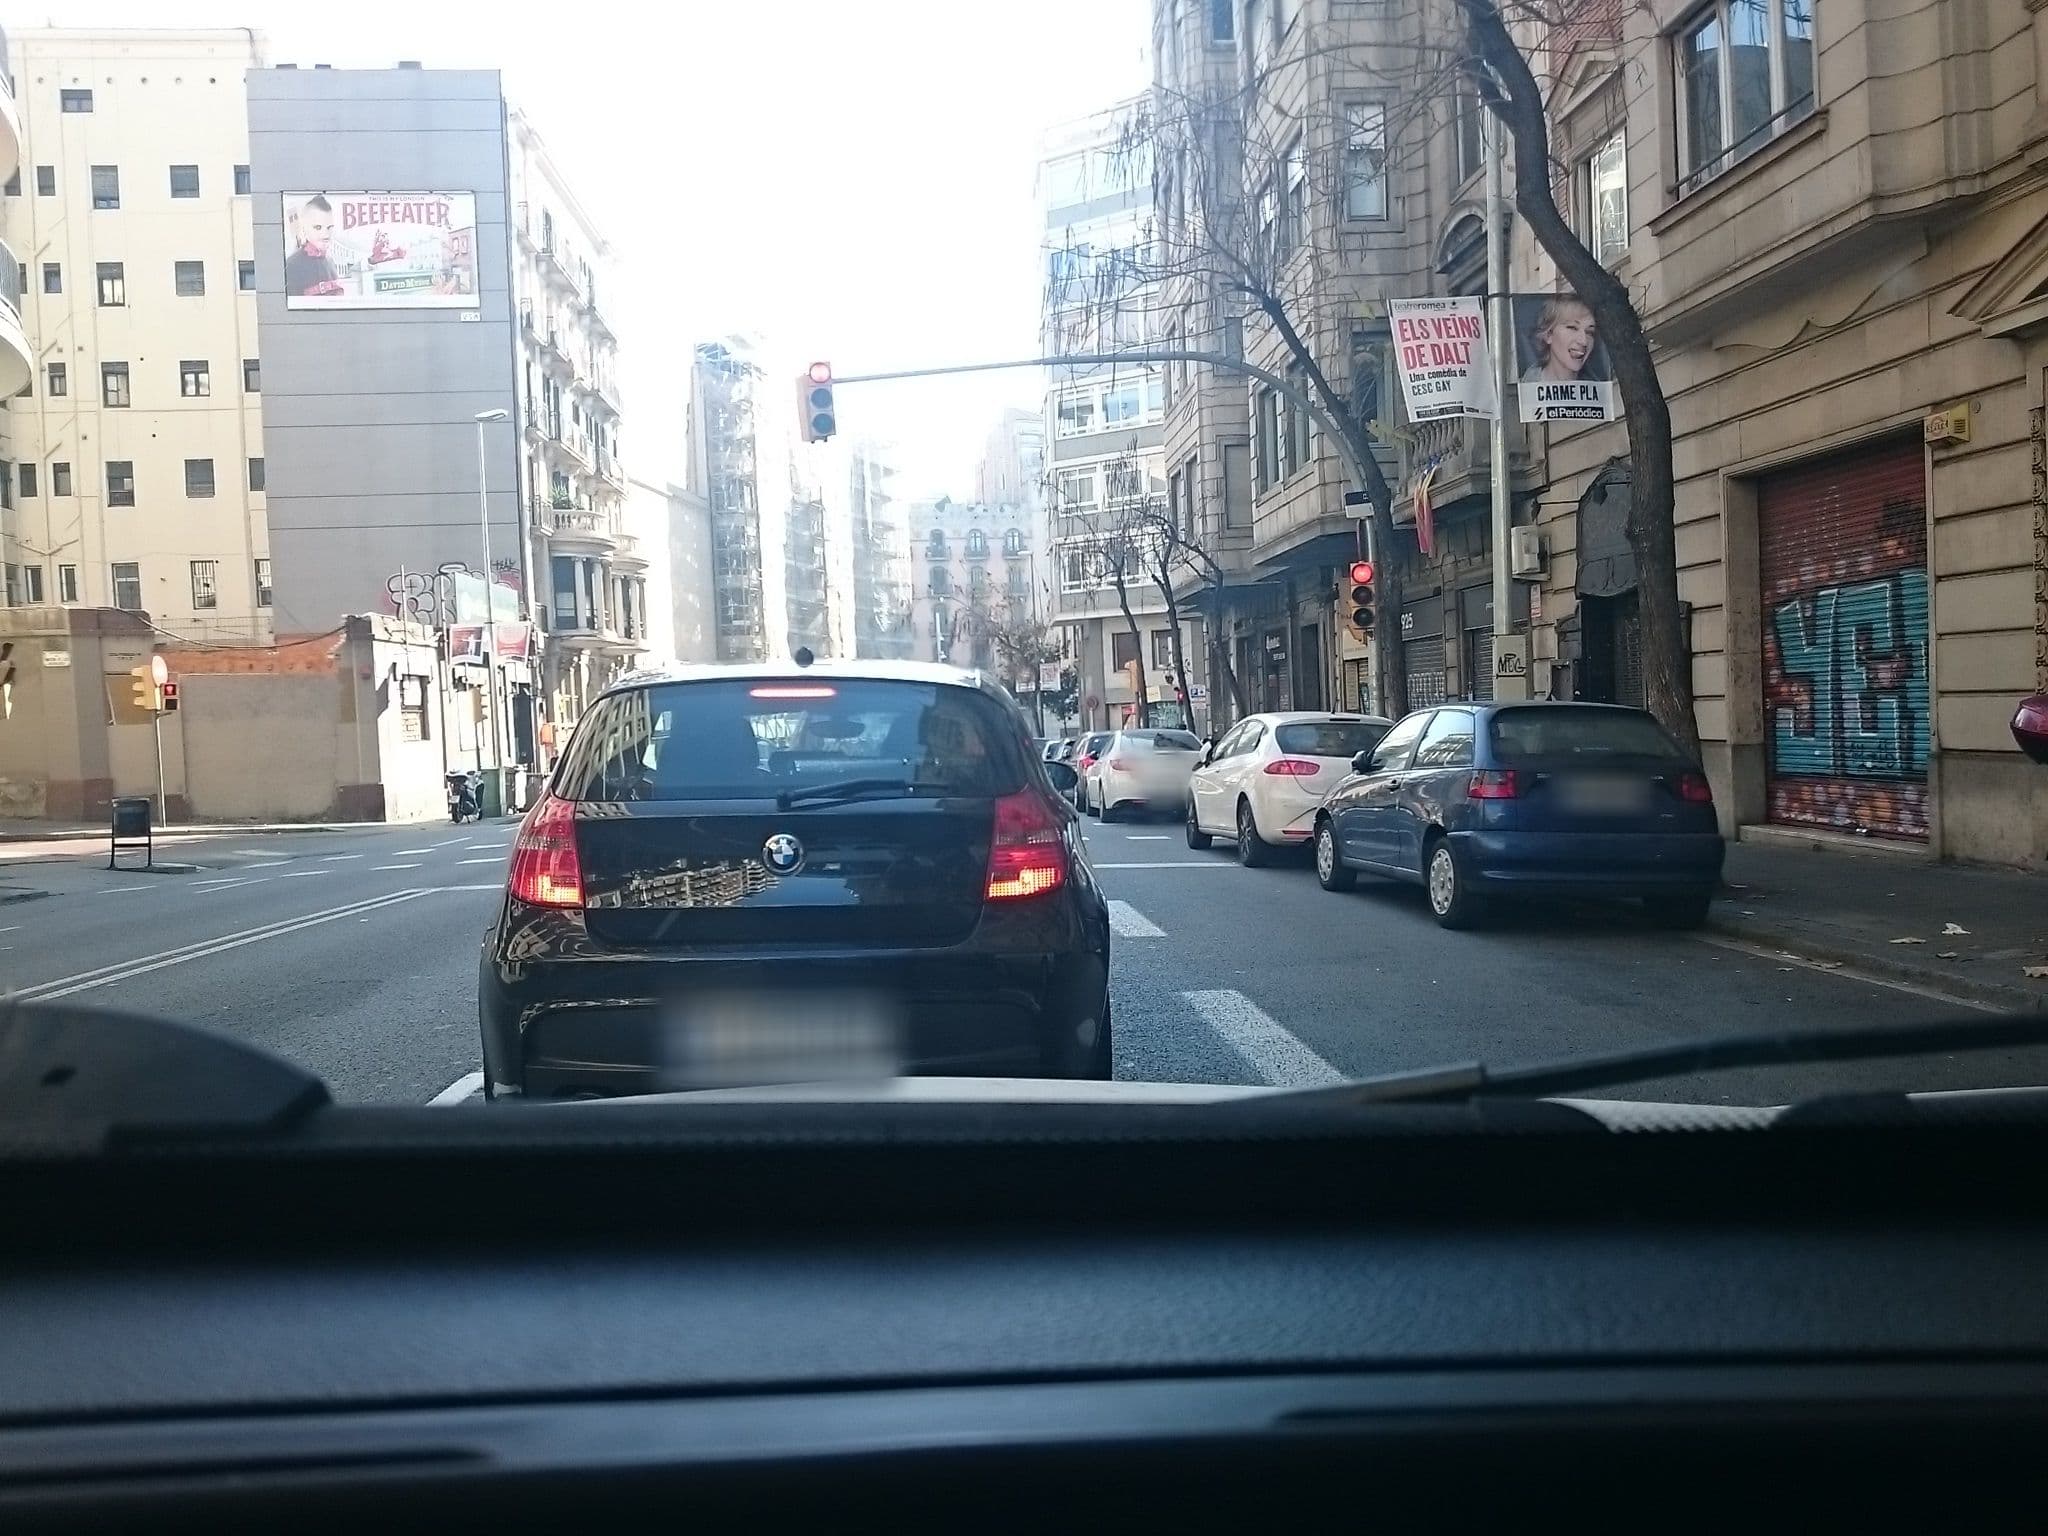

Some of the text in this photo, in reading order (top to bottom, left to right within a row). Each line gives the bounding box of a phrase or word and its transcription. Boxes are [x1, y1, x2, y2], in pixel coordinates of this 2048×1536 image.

[342, 202, 451, 230] BEEFEATER
[1398, 313, 1481, 342] ELS VEÏNS
[1403, 342, 1471, 370] DE DALT
[1409, 372, 1425, 383] Una
[1459, 368, 1467, 377] de
[1411, 380, 1451, 396] CESC GAY
[1537, 384, 1599, 401] CARME PLA
[1549, 407, 1603, 418] el Periódico
